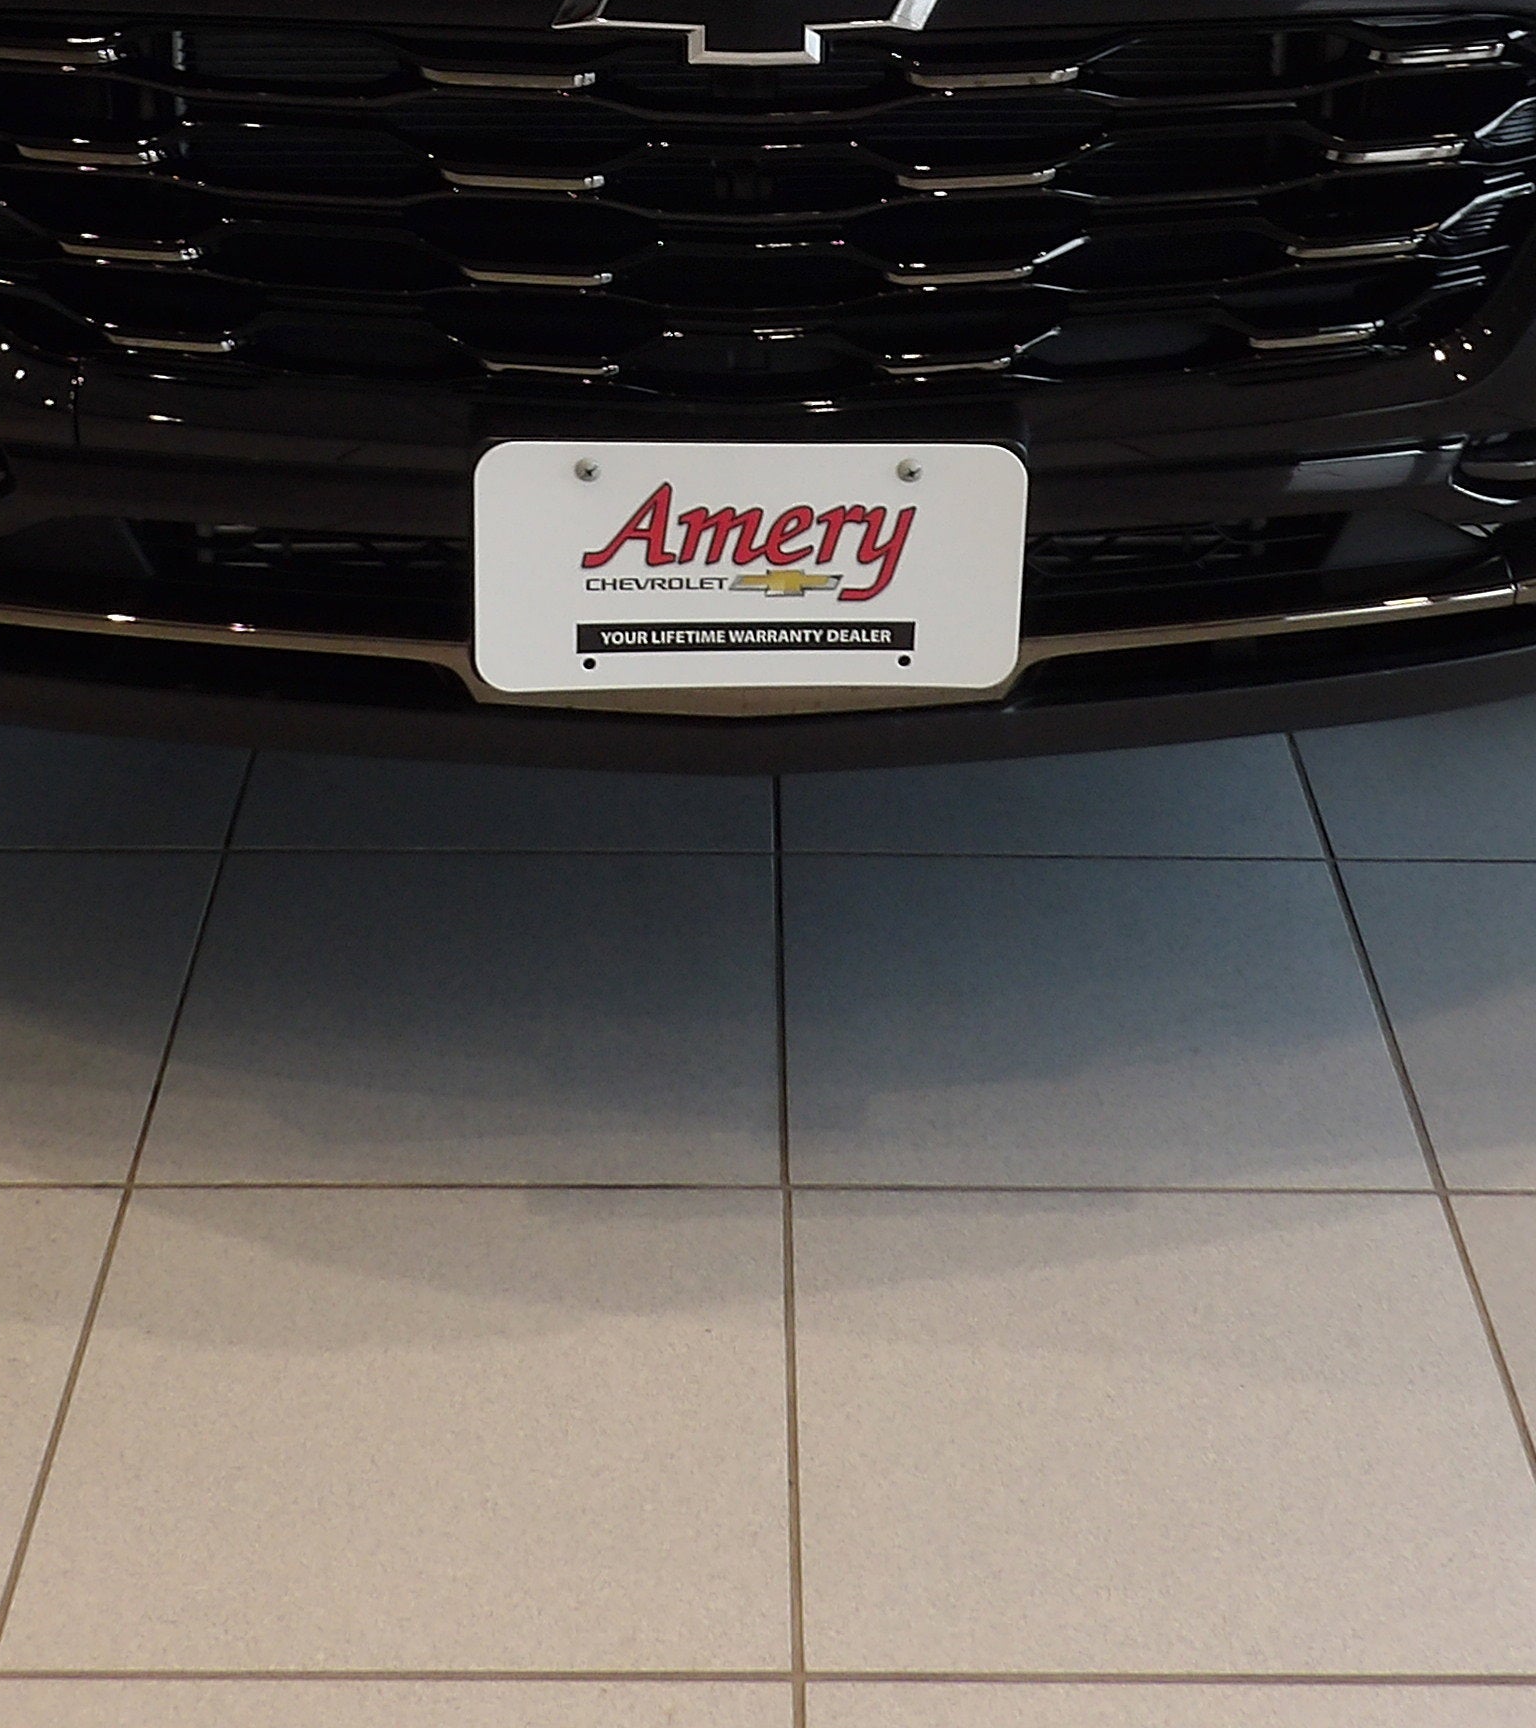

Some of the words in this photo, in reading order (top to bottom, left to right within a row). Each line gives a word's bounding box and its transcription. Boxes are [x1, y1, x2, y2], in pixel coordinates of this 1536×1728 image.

[581, 482, 917, 602] Amery
[585, 577, 729, 591] CHEVROLET
[600, 630, 649, 646] YOUR
[650, 629, 726, 645] LIFETIME
[727, 628, 824, 644] WARRANTY
[826, 628, 892, 644] DEALER
